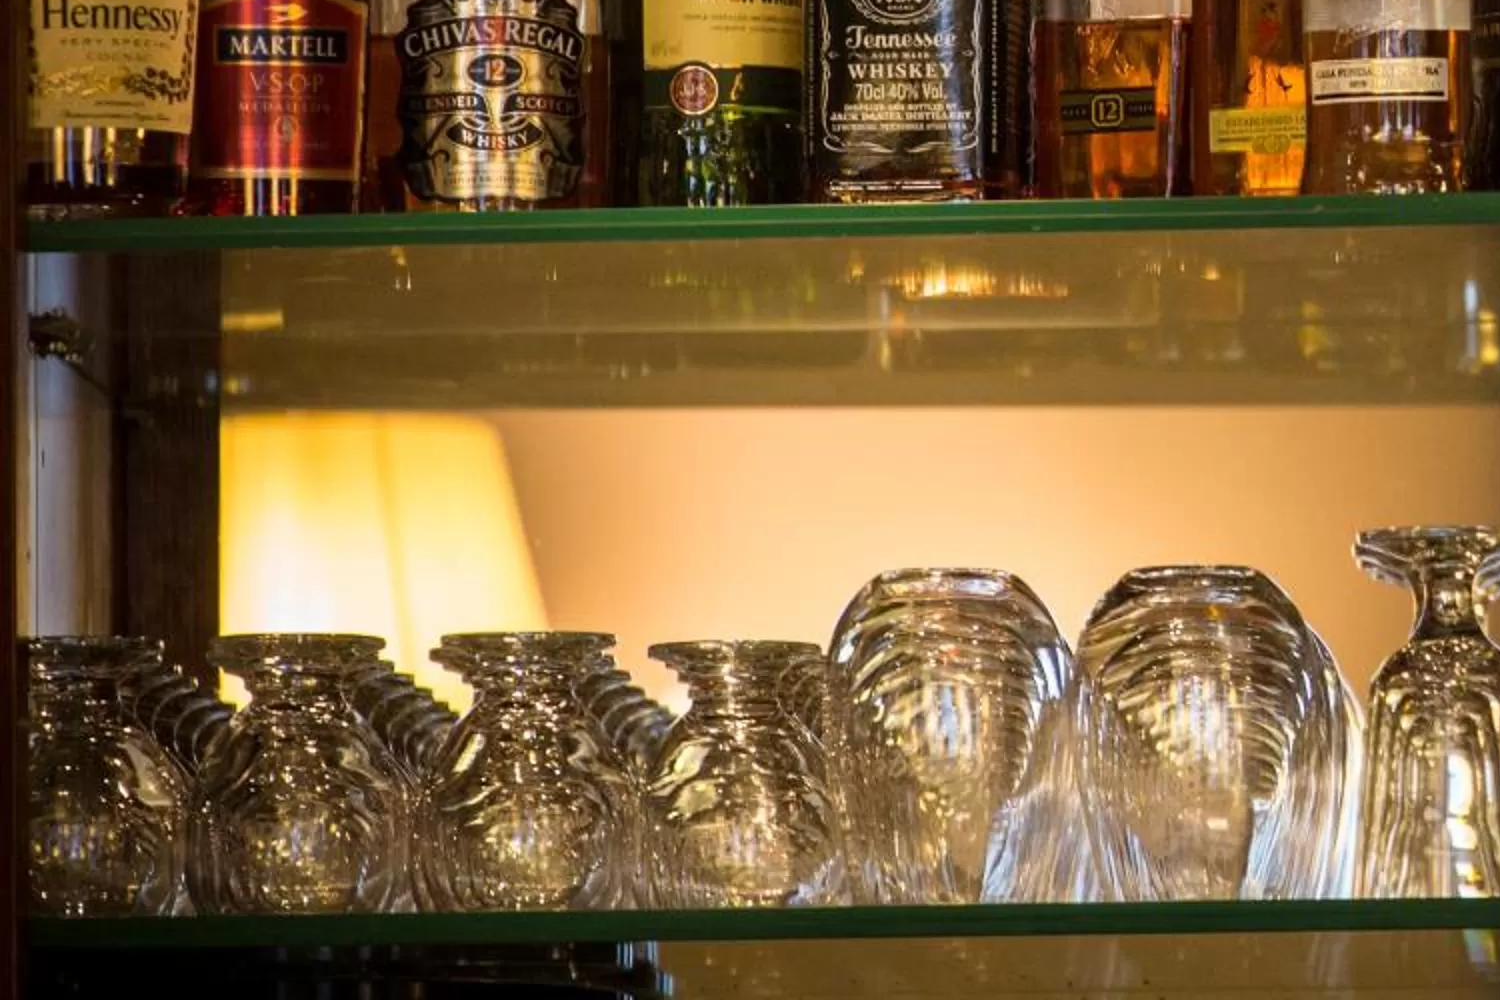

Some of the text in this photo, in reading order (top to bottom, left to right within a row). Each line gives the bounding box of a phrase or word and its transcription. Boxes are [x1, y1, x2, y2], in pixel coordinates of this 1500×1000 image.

[229, 35, 338, 58] MARTELL
[404, 18, 577, 60] CHIVAS REGAL
[845, 25, 957, 49] Tennessee
[483, 59, 506, 82] 12
[847, 63, 955, 80] WHISKEY
[855, 83, 885, 100] 70cl
[409, 95, 576, 110] BLENDED SCOTCH
[1097, 101, 1117, 121] 12
[460, 129, 529, 149] WHISKY
